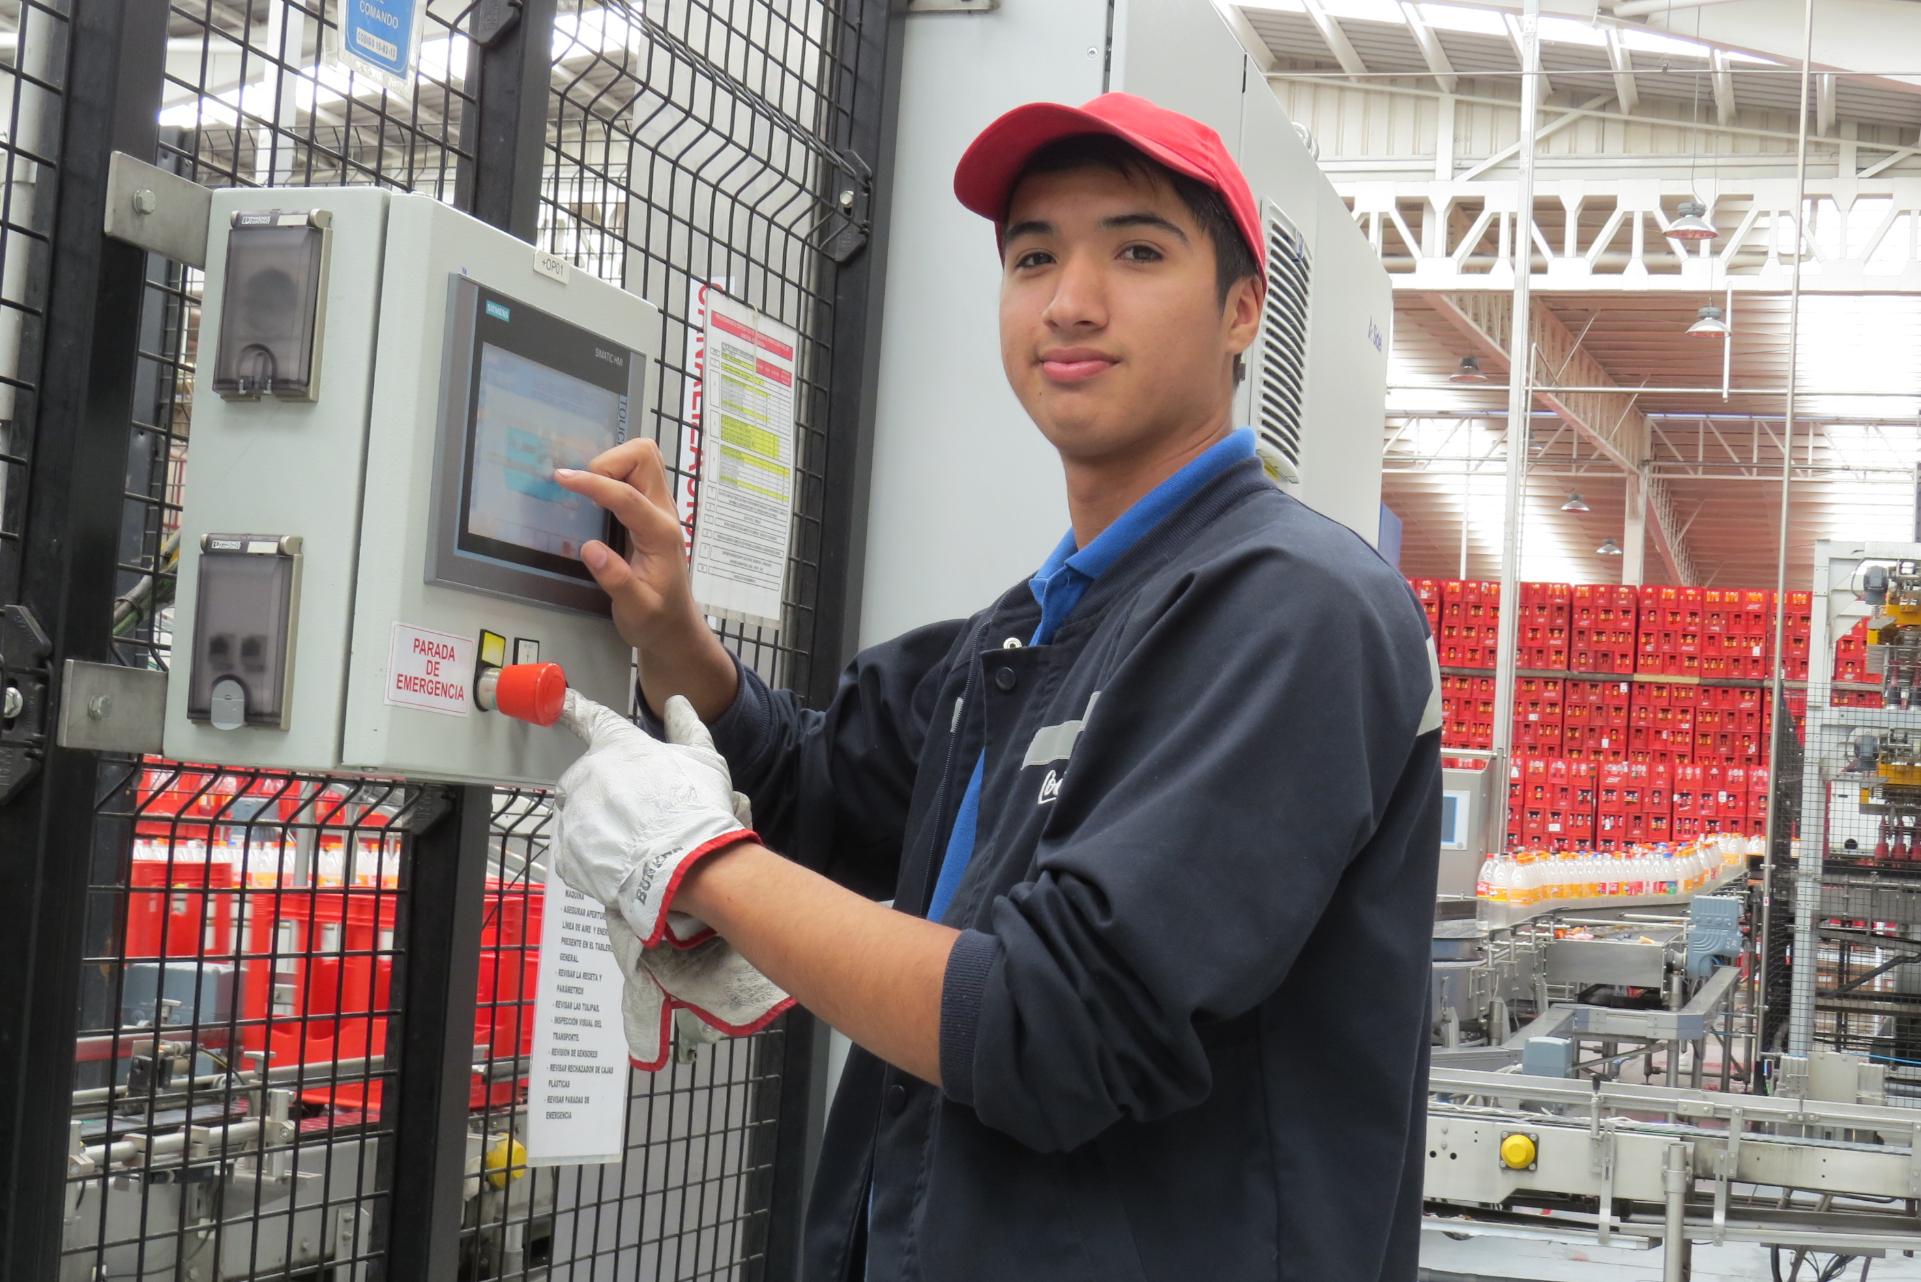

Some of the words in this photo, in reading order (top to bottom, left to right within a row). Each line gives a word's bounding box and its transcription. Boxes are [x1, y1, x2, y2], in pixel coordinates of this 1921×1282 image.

[360, 1, 398, 29] COMANDO
[487, 303, 510, 319] SIEMENS
[594, 348, 614, 364] SIMATIC
[614, 354, 624, 367] HMI
[413, 638, 456, 662] PARADA
[426, 660, 440, 677] DE
[396, 674, 464, 701] EMERGENCIA
[564, 905, 586, 917] ASEGURAR
[575, 924, 581, 932] DE
[582, 924, 591, 934] AIRE
[593, 926, 597, 935] Y
[597, 927, 608, 936] ENER
[561, 936, 582, 948] PRESENTE
[582, 940, 589, 949] EN
[589, 941, 594, 950] EL
[595, 942, 614, 952] TABLER
[558, 968, 576, 979] REVISAR
[576, 971, 581, 979] LA
[582, 972, 598, 981] RECETA
[555, 1000, 572, 1010] REVISAR
[573, 1002, 581, 1010] LAS
[579, 1018, 593, 1027] VISUAL
[594, 1019, 602, 1028] DEL
[570, 1049, 576, 1057] DE
[577, 1050, 598, 1058] SENSORES
[550, 1064, 567, 1072] REVISAR
[568, 1064, 594, 1074] RECHAZADOR
[595, 1066, 600, 1074] DE
[601, 1066, 614, 1074] CAJAS
[547, 1095, 564, 1104] REVISAR
[565, 1096, 583, 1104] PARADAS
[584, 1096, 590, 1104] DE
[546, 1111, 572, 1120] EMERGENCIA
